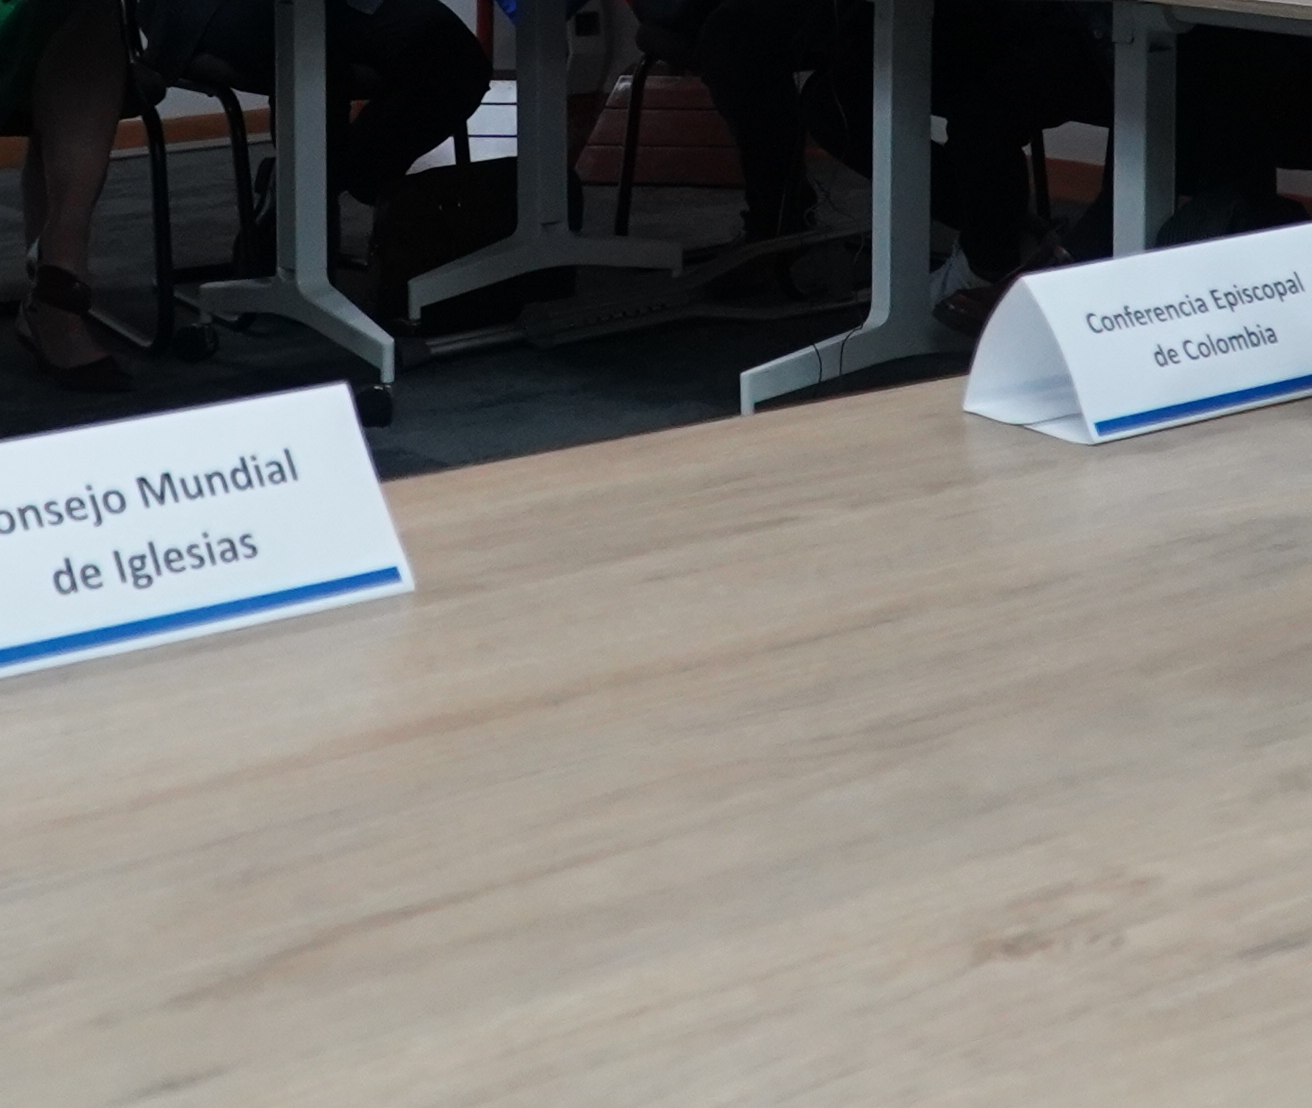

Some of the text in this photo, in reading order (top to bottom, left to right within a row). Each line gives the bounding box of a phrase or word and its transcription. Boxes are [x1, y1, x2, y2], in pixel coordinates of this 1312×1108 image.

[1086, 271, 1306, 334] Conferencia Episcopal
[1153, 323, 1279, 369] de Colombia
[135, 447, 300, 508] Mundial
[52, 527, 259, 595] de Iglesias
